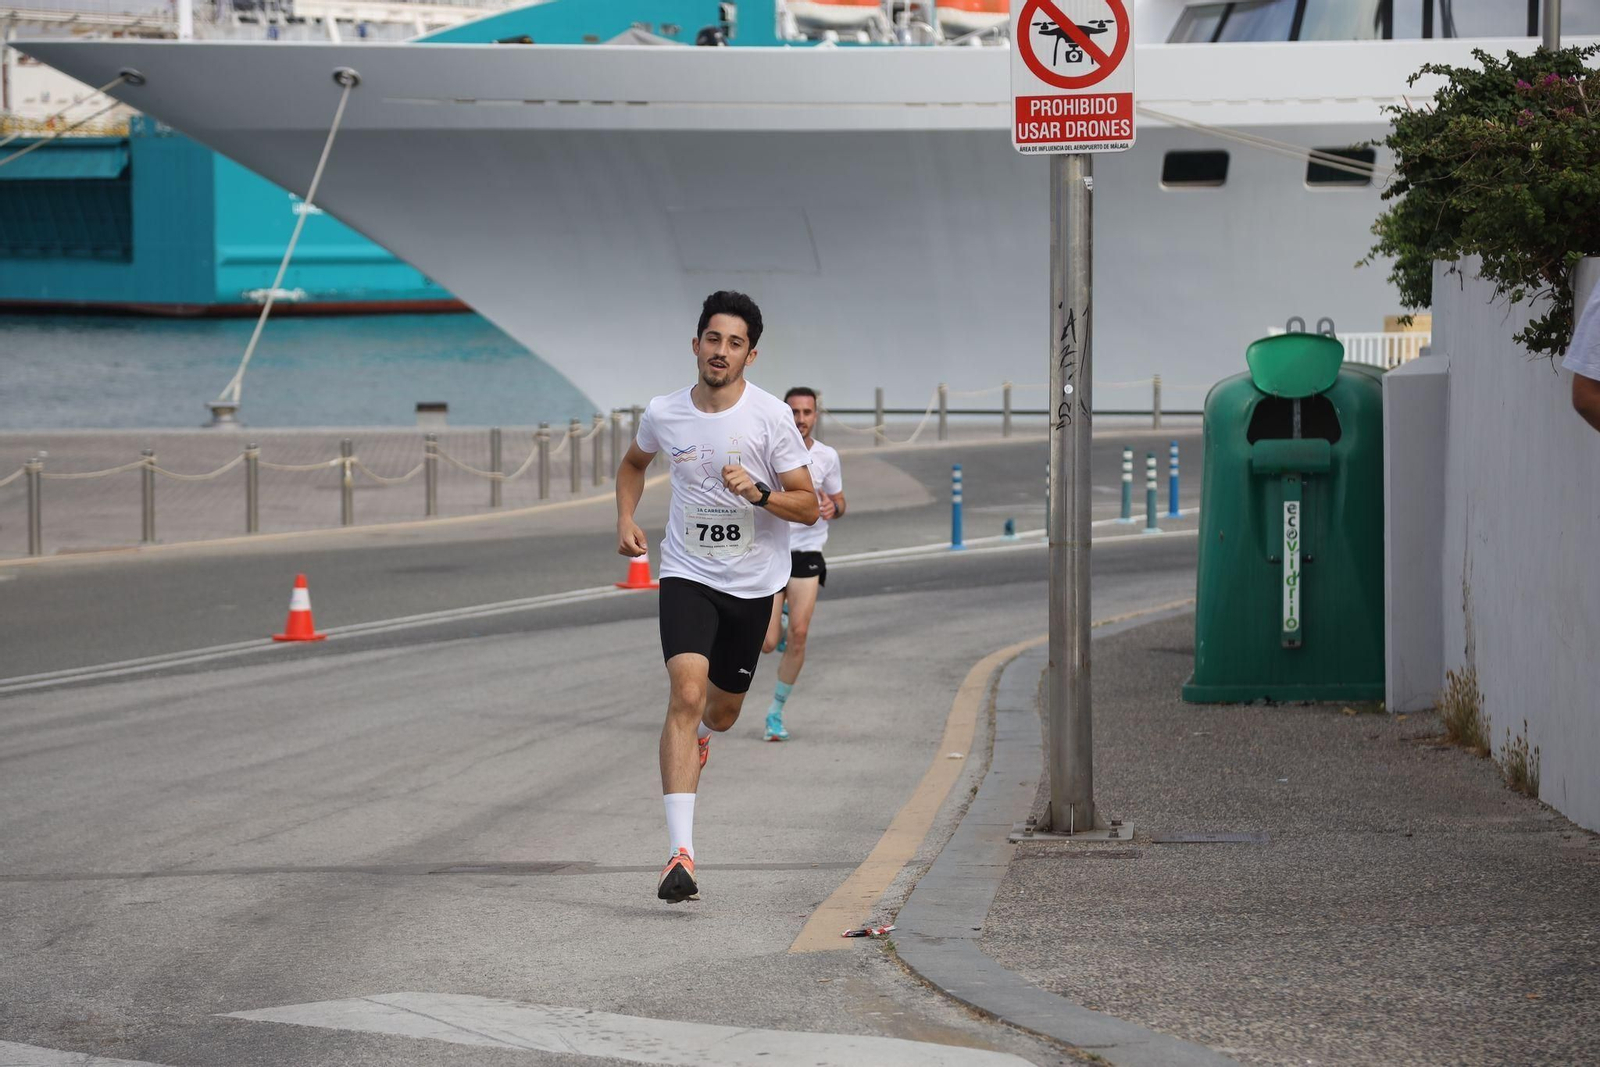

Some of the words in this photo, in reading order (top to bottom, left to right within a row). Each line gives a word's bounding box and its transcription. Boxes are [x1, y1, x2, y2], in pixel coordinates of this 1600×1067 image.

[1030, 97, 1118, 117] PROHIBIDO
[1018, 121, 1061, 140] USAR
[1065, 119, 1131, 138] DRONES
[696, 523, 741, 542] 788
